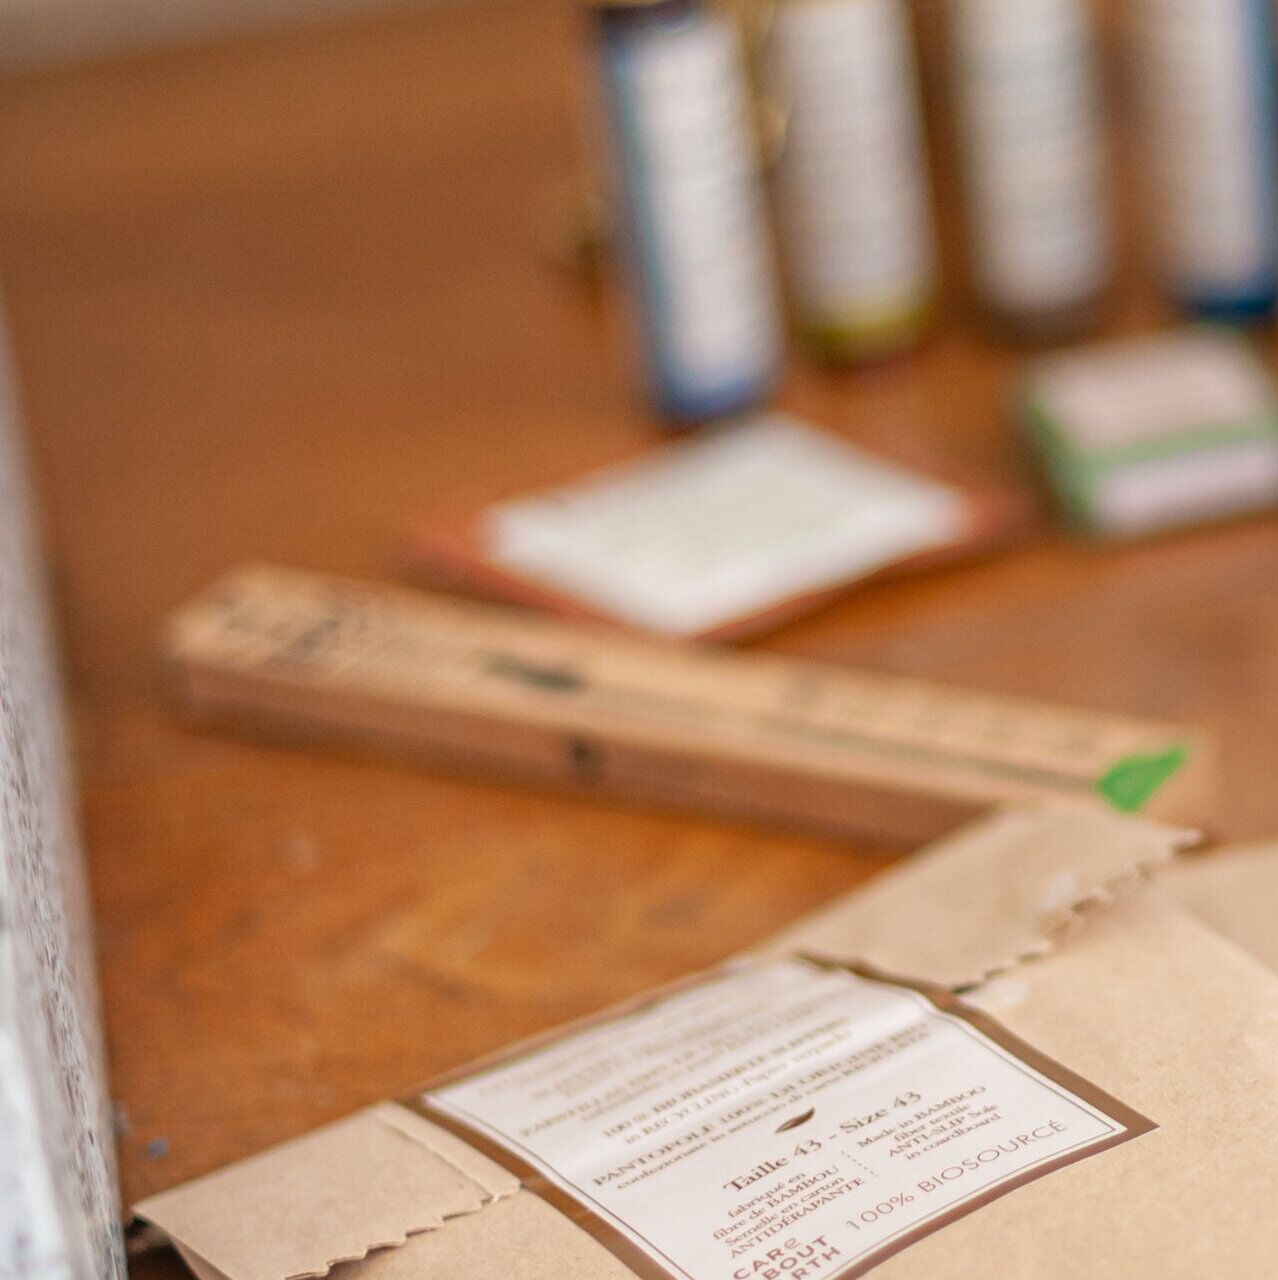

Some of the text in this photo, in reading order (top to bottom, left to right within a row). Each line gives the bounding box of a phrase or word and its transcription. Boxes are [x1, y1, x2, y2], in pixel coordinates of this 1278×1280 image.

[708, 1132, 726, 1143] in
[722, 1157, 787, 1192] Taille
[792, 1138, 822, 1157] 43
[838, 1107, 887, 1134] Size
[892, 1090, 922, 1108] 43
[856, 1085, 987, 1148] Made in BAMBOO
[888, 1103, 998, 1158] ANTI-SLIP Sole
[892, 1104, 970, 1143] fiber textile
[844, 1118, 1068, 1230] 100% BIOSOURCÉ
[904, 1150, 922, 1161] in
[711, 1164, 839, 1241] fibre de BAMBOU
[723, 1176, 845, 1247] Semelle en carton
[726, 1171, 807, 1219] fabriqué en
[730, 1176, 866, 1259] ANTIDÉRAPANTE
